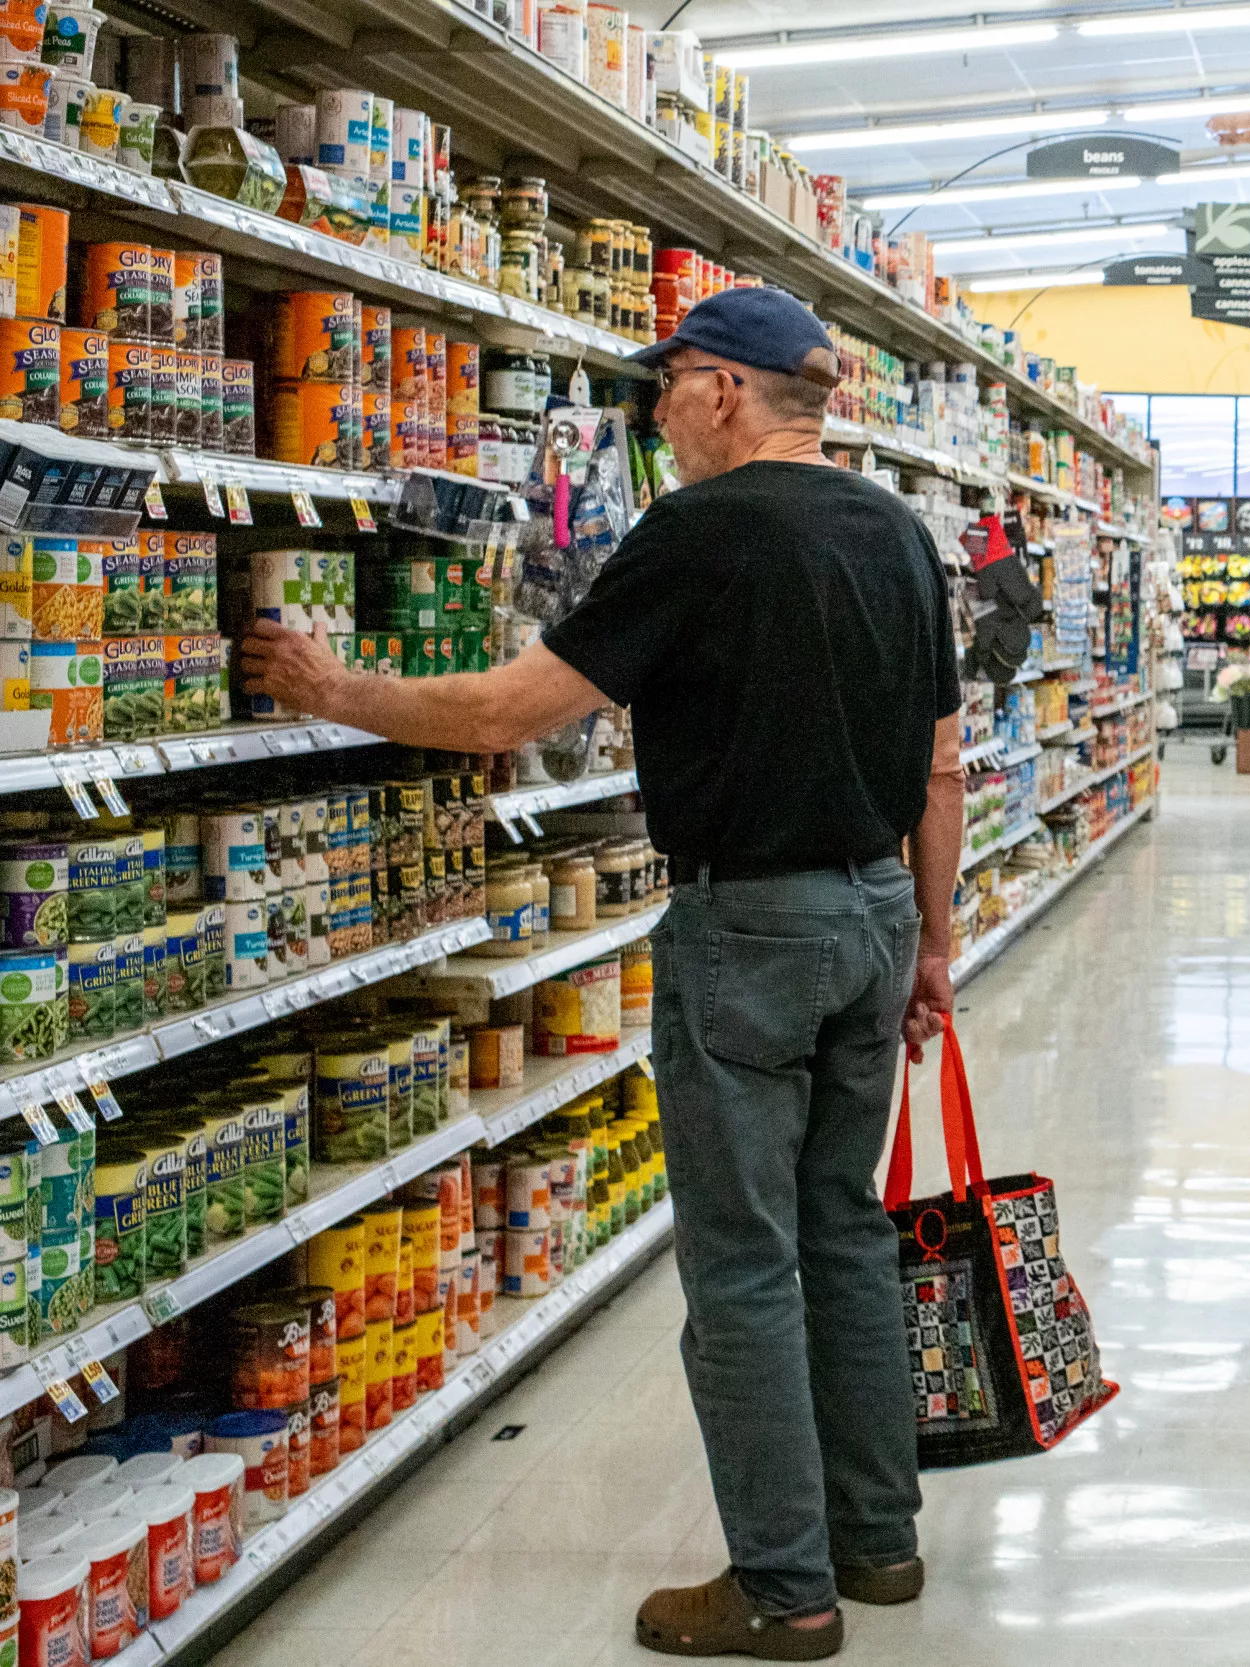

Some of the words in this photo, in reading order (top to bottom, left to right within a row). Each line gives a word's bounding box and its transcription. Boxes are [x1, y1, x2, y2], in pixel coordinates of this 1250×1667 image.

[52, 36, 72, 46] Peas
[1083, 149, 1124, 163] beans
[1134, 265, 1183, 276] tomatoes
[83, 1361, 103, 1385] 1.59
